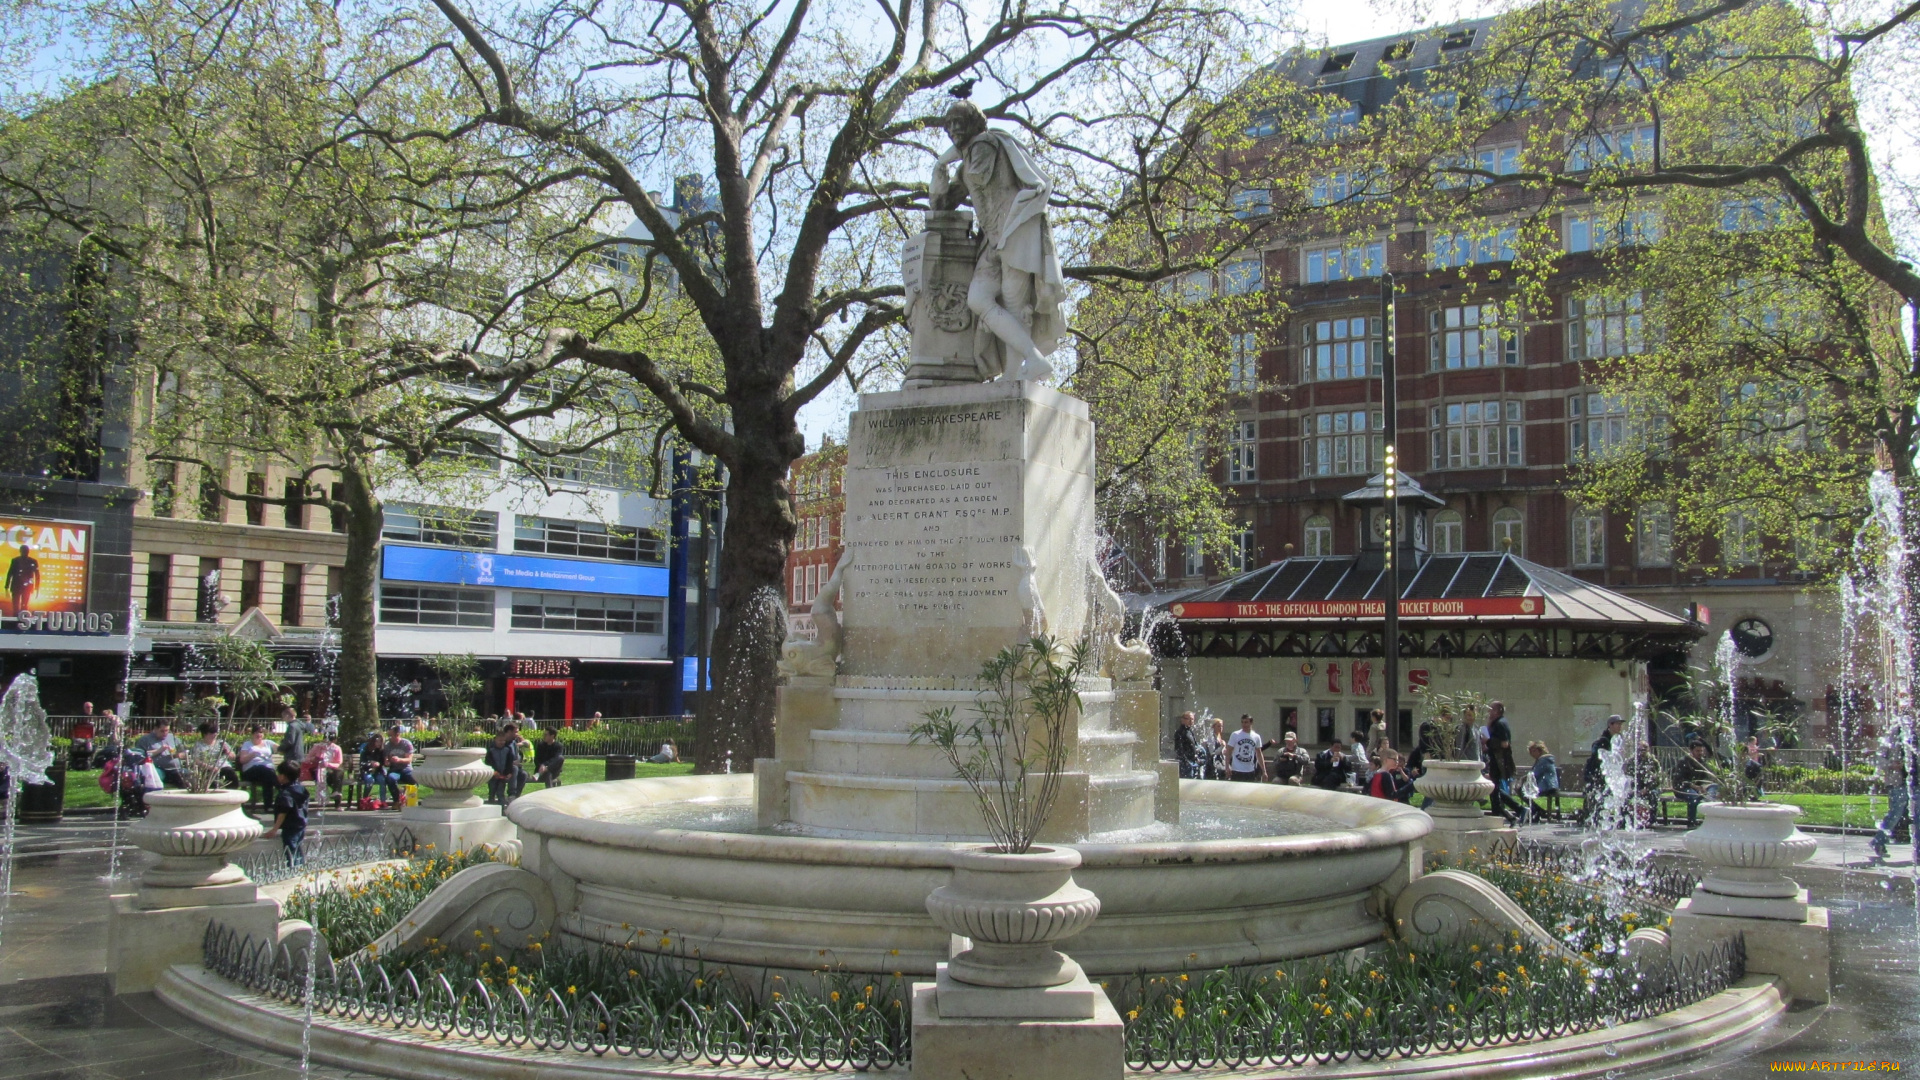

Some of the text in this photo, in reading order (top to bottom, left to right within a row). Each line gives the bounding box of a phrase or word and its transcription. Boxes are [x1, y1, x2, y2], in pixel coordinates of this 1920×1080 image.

[868, 411, 1002, 429] WILLIAM SHAKESPEARE
[886, 468, 980, 480] THIS ENCLOSURE
[951, 483, 970, 491] LAID
[888, 498, 936, 506] DECORATED
[963, 495, 998, 503] GARDEN
[914, 510, 949, 520] GRANT
[991, 507, 1012, 516] M.P.
[853, 563, 921, 572] METROPOLITAN
[962, 562, 974, 570] OF
[979, 561, 1012, 569] WORKS
[476, 575, 495, 585] global
[504, 568, 515, 576] The
[515, 569, 534, 577] Media
[540, 571, 578, 580] Entertainment
[578, 573, 596, 582] Group
[957, 589, 1009, 597] ENJOYMENT
[1237, 604, 1258, 616] TKTS
[1265, 603, 1282, 615] THE
[1283, 603, 1320, 615] OFFICIAL
[1322, 602, 1358, 615] LONDON
[1359, 602, 1386, 615] THEAT
[1399, 602, 1431, 614] TICKET
[1432, 601, 1464, 614] BOOTH
[18, 610, 114, 633] STUDIOS
[516, 659, 571, 675] FRIDAYS
